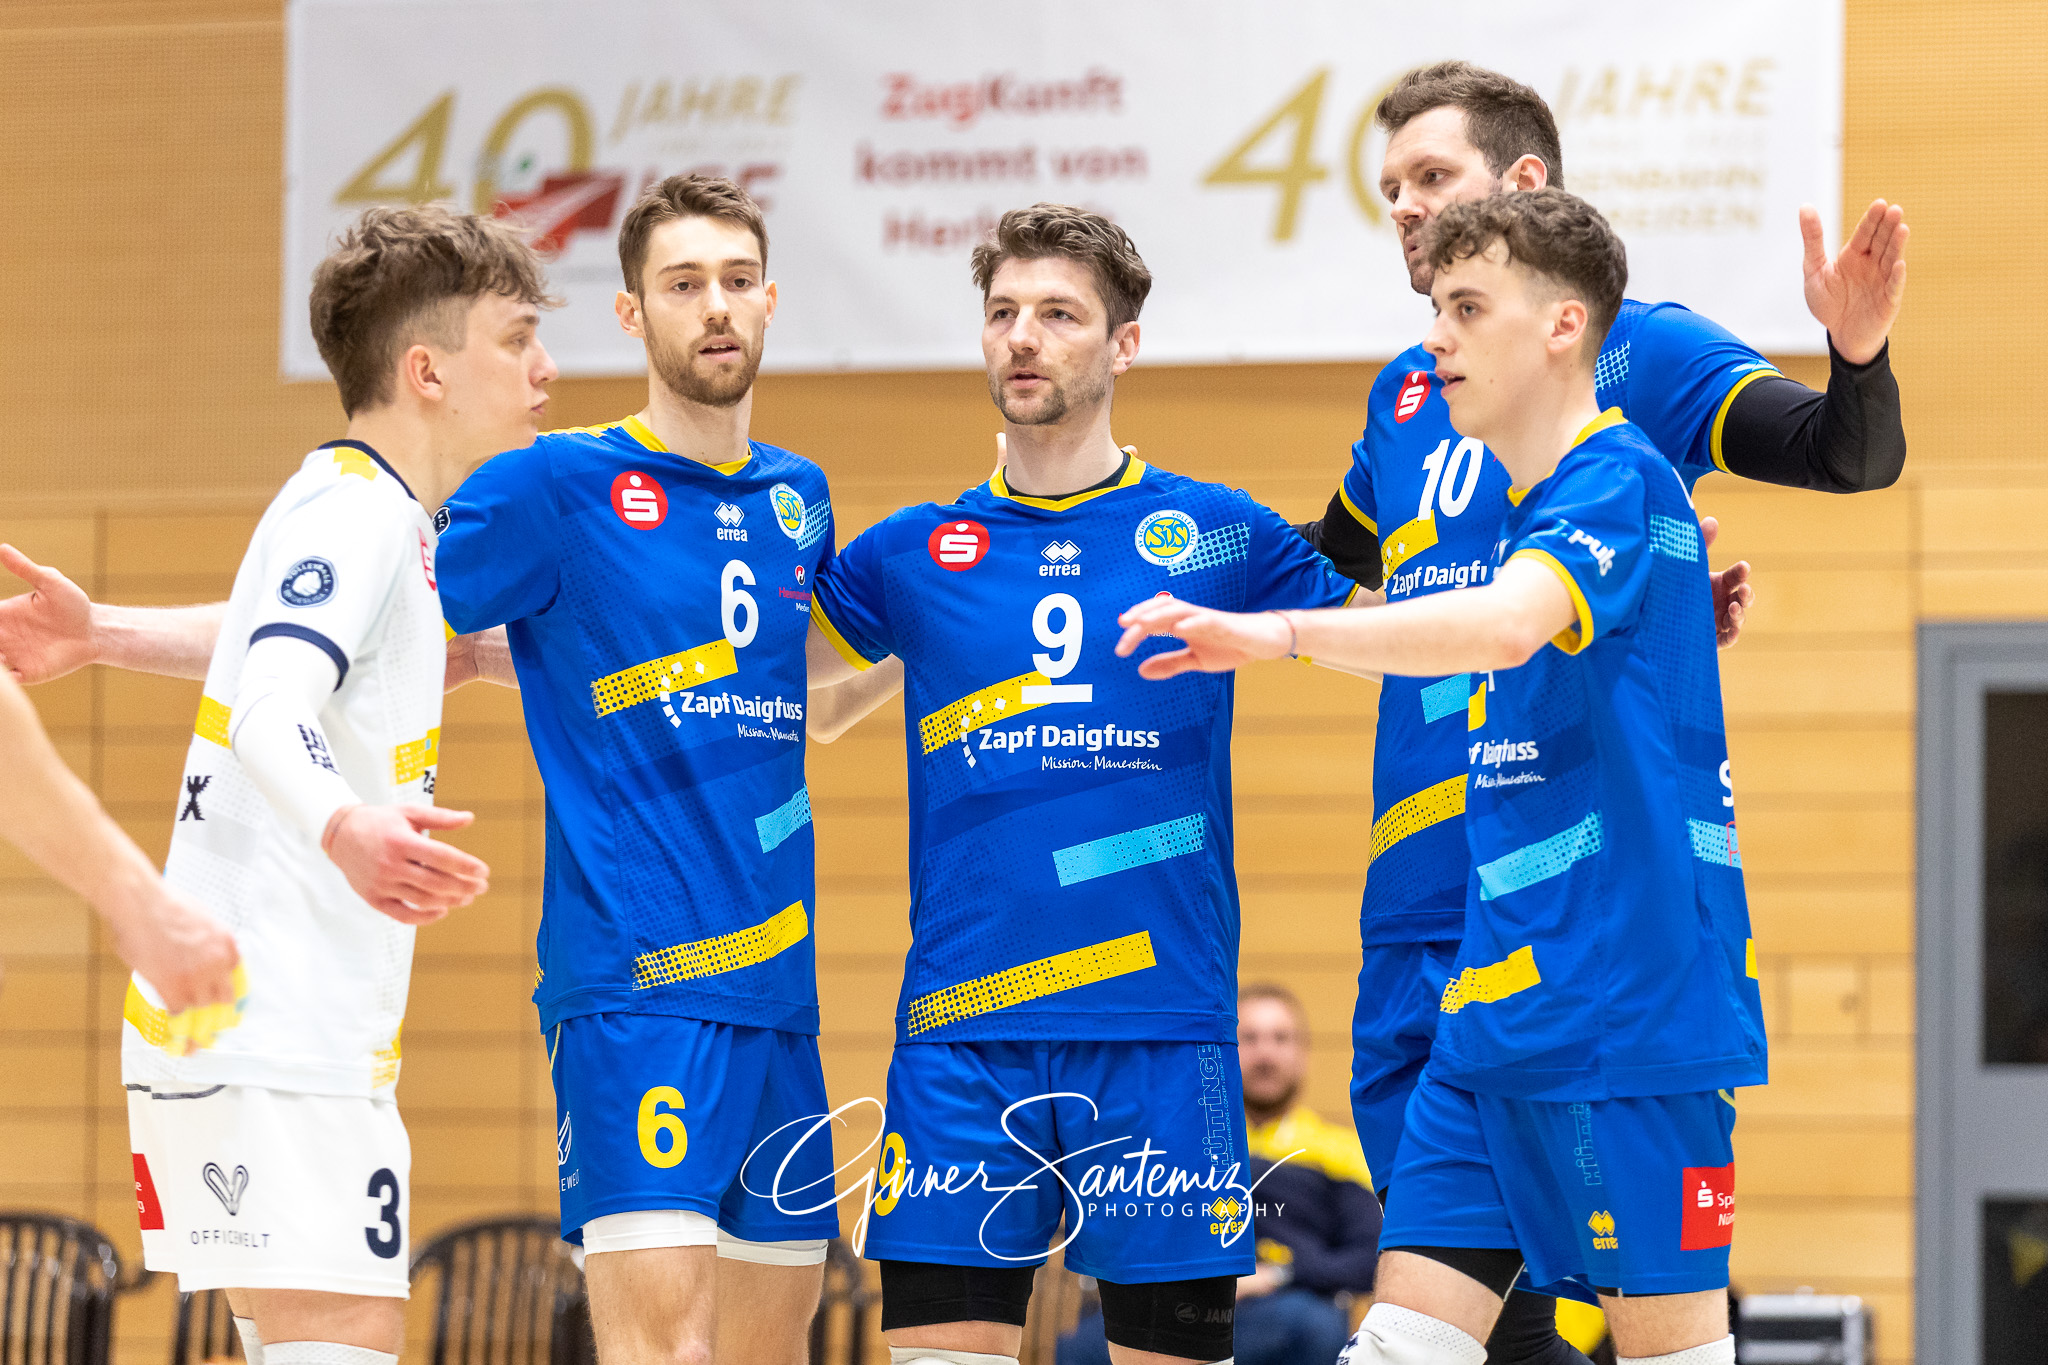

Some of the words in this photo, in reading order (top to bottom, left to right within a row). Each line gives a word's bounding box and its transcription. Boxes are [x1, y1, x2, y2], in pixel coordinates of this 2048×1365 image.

[1555, 60, 1777, 126] JAHRE
[855, 142, 1037, 185] kommt
[1050, 147, 1149, 182] von
[1417, 436, 1484, 521] 10
[716, 527, 748, 542] errea
[1039, 563, 1081, 577] errea
[1391, 566, 1423, 597] Zapf
[720, 559, 760, 649] 6
[1032, 593, 1084, 679] 9
[680, 692, 731, 718] Zapf
[731, 695, 803, 723] Daigfuss
[979, 725, 1037, 754] Zapf
[1042, 724, 1160, 752] Daigfuss
[1041, 755, 1092, 771] Mission:
[1094, 754, 1163, 771] Mauerstein
[637, 1086, 688, 1169] 6
[875, 1132, 907, 1217] 9
[365, 1167, 401, 1260] 3
[1204, 1307, 1234, 1324] JAKO
